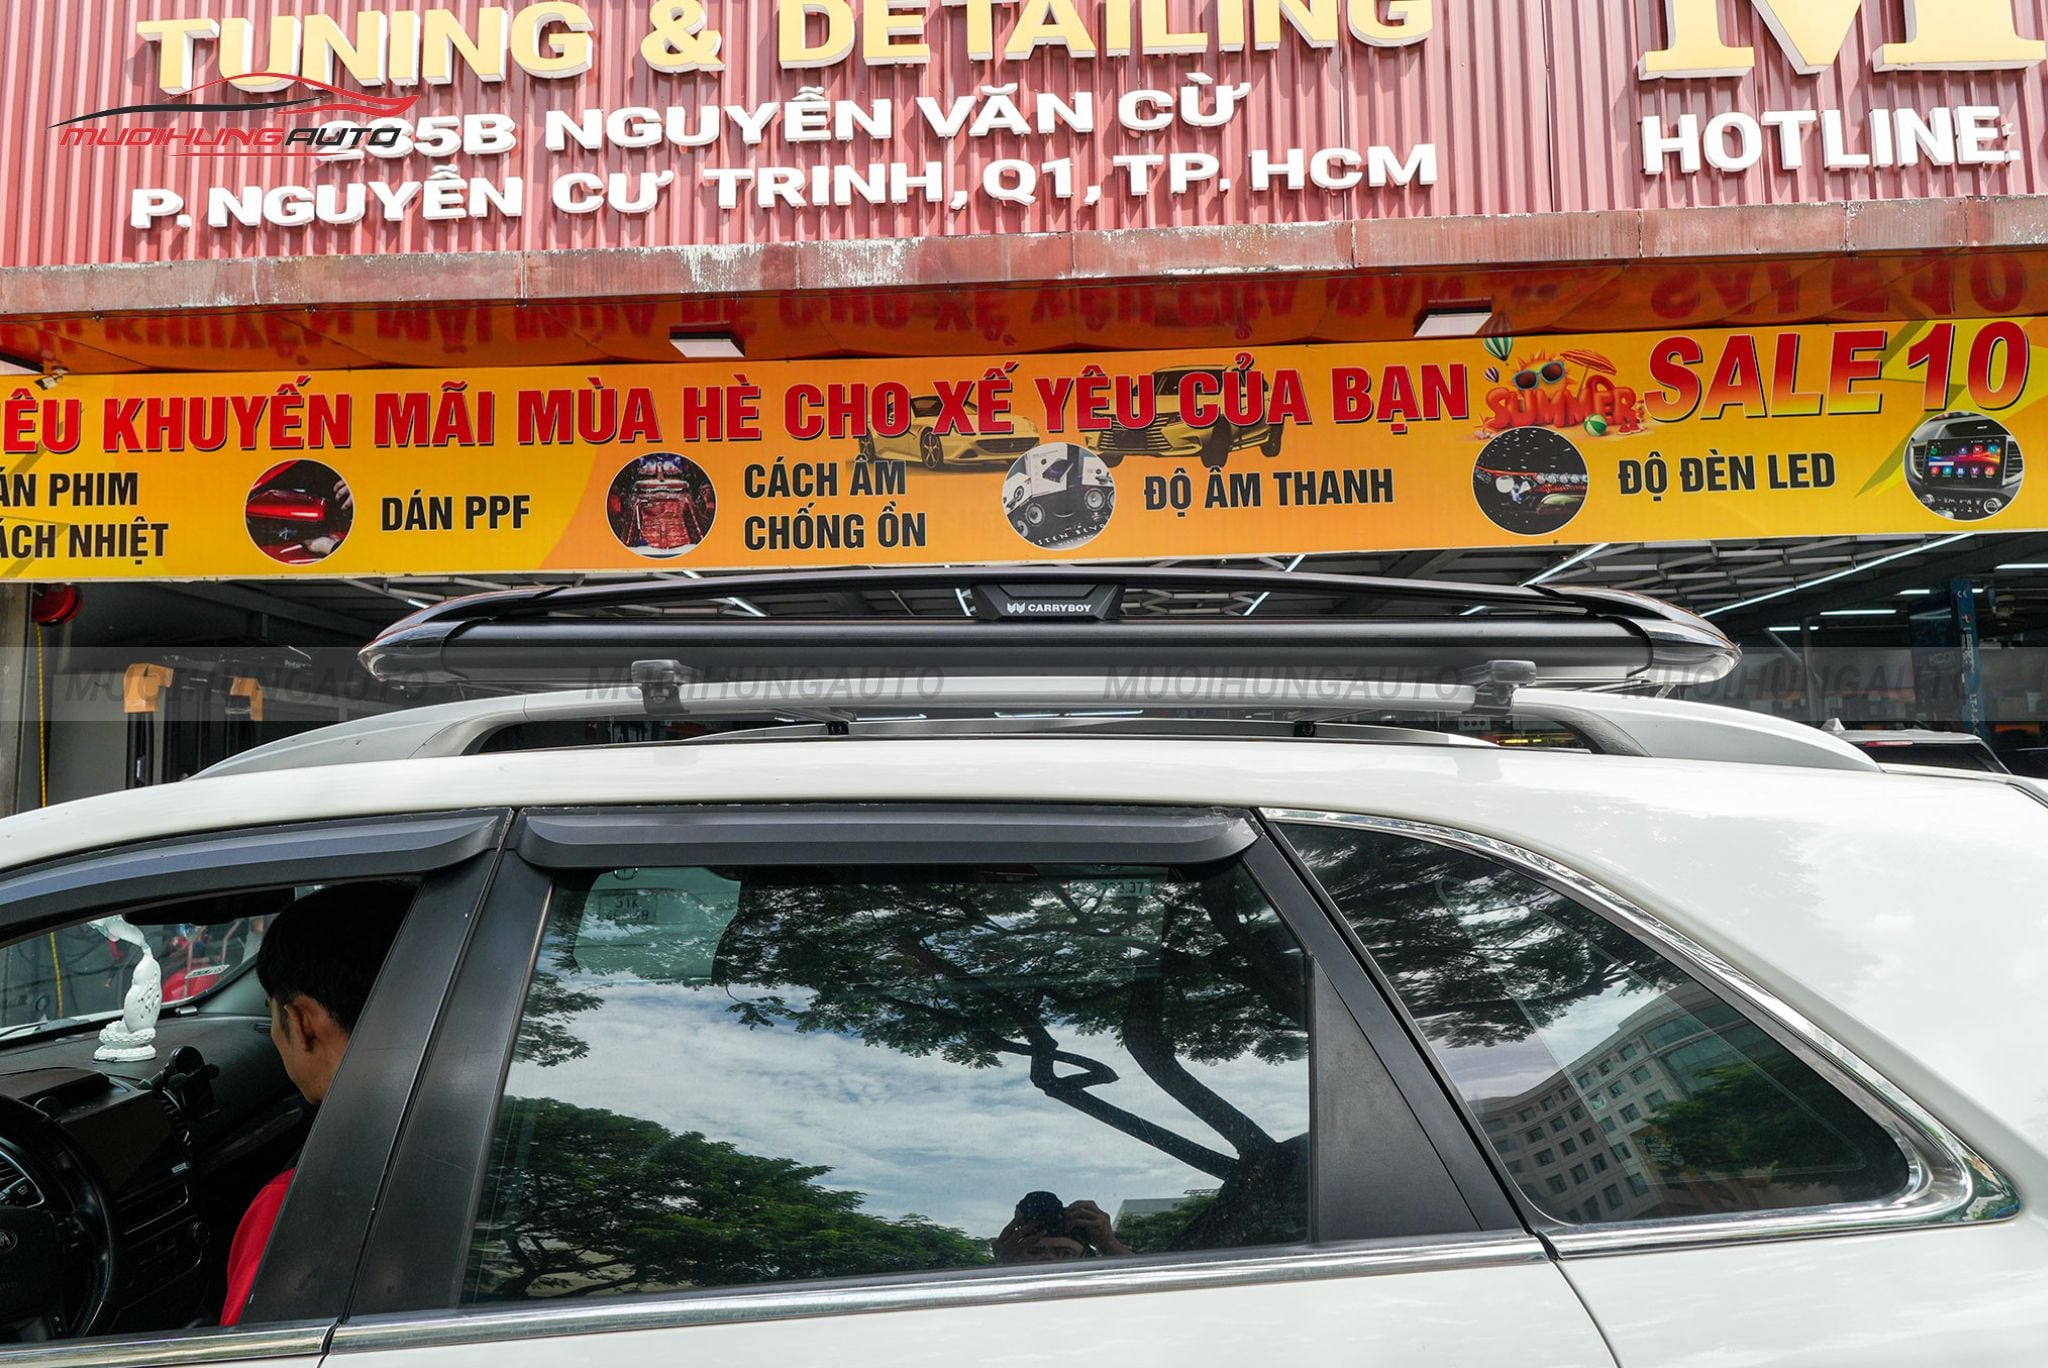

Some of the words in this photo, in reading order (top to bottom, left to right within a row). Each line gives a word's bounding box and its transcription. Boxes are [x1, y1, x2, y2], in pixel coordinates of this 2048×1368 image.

[137, 0, 592, 96] TUNING
[640, 0, 726, 73] &
[778, 0, 1435, 70] DETAILING
[544, 86, 892, 152] NGUYỄN
[916, 82, 1094, 139] VĂN
[1118, 72, 1251, 131] CỪ
[130, 187, 192, 229] P.
[208, 163, 524, 228] NGUYỄN
[552, 168, 674, 216] CƯ
[701, 161, 967, 211] TRINH,
[983, 157, 1101, 207] Q1,
[1113, 152, 1231, 196] TP.
[1251, 143, 1437, 192] HCM
[1642, 329, 1888, 423] SALE
[1906, 321, 2030, 411] 10
[102, 376, 352, 451] KHUYẾN
[373, 380, 496, 448] MÃI
[517, 377, 663, 445] MÙA
[682, 374, 762, 441] HÈ
[784, 381, 913, 439] CHO
[931, 361, 1017, 435] XẾ
[1034, 365, 1156, 433] YÊU
[1179, 352, 1312, 428] CỦA
[1331, 362, 1470, 434] BẠN
[1485, 374, 1637, 429] SUMMER
[49, 472, 138, 507] PHIM
[743, 456, 838, 499] CÁCH
[850, 455, 907, 497] ÂM
[1144, 467, 1193, 517] ĐỘ
[1206, 466, 1261, 509] ÂM
[1272, 468, 1394, 506] THANH
[1617, 451, 1668, 502] ĐỘ
[1680, 448, 1756, 493] ĐÈN
[1767, 451, 1836, 490] LED
[382, 489, 454, 533] DÁN
[465, 495, 531, 531] PPF
[743, 503, 864, 551] CHỐNG
[877, 501, 927, 549] ỒN
[69, 516, 169, 566] NHIỆT
[1027, 603, 1092, 613] CARRYBOY
